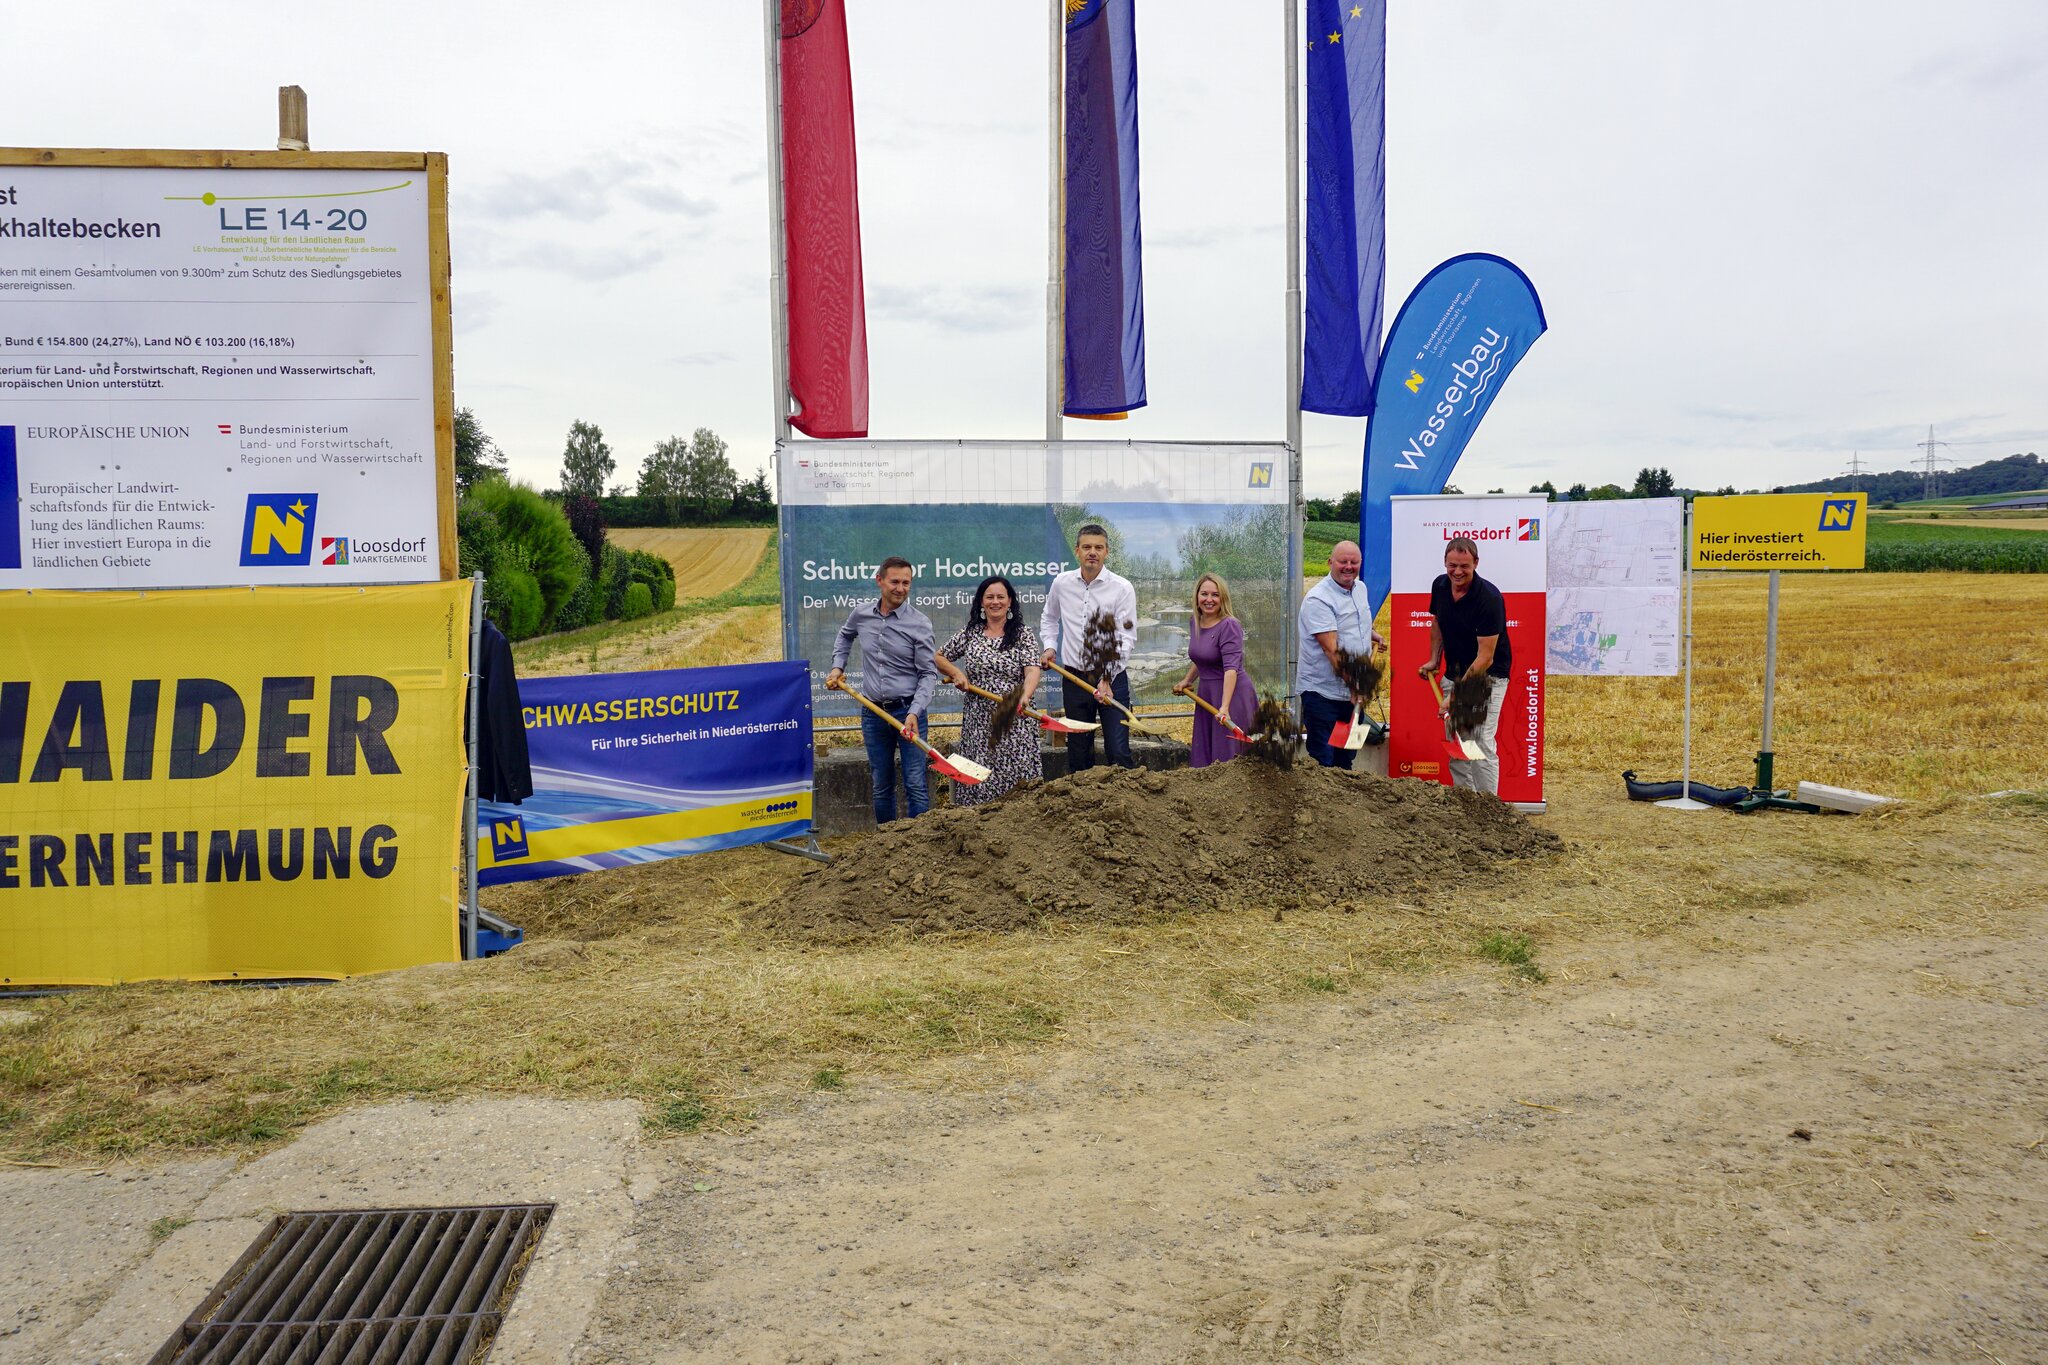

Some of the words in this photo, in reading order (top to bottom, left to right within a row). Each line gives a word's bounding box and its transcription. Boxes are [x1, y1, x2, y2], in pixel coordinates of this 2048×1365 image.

[220, 208, 267, 231] LE
[221, 236, 267, 244] Entwicklung
[270, 236, 281, 244] für
[283, 236, 297, 244] den
[300, 235, 342, 244] Ländlichen
[344, 236, 365, 244] Raum
[21, 267, 37, 277] mit
[40, 267, 71, 277] einem
[75, 267, 157, 277] Gesamtvolumen
[252, 268, 286, 278] Schutz
[289, 268, 307, 278] des
[311, 268, 402, 280] Siedlungsgebietes
[1460, 278, 1481, 306] Regionen
[1423, 292, 1463, 350] Bundesministerium
[5, 337, 34, 347] Bund
[37, 337, 43, 346] €
[47, 336, 88, 347] 154.800
[92, 336, 141, 348] (24,27%),
[144, 336, 171, 347] Land
[174, 335, 191, 347] NÖ
[195, 337, 201, 347] €
[205, 337, 246, 347] 103.200
[249, 337, 295, 348] (16,18%)
[1438, 346, 1447, 358] und
[1444, 315, 1467, 345] Tourismus
[36, 365, 51, 375] für
[54, 365, 86, 375] Land-
[89, 365, 110, 375] und
[114, 365, 198, 376] Forstwirtschaft,
[201, 366, 253, 377] Regionen
[256, 366, 277, 375] und
[280, 365, 376, 376] Wasserwirtschaft,
[67, 379, 99, 389] Union
[103, 379, 164, 389] unterstützt.
[1394, 327, 1501, 470] Wasserbau
[28, 425, 136, 438] EUROPÄISCHE
[140, 426, 190, 438] UNION
[239, 425, 348, 434] Bundesministerium
[240, 439, 272, 449] Land-
[276, 439, 296, 448] und
[301, 438, 393, 449] Forstwirtschaft,
[241, 454, 292, 466] Regionen
[296, 454, 317, 463] und
[322, 453, 423, 463] Wasserwirtschaft
[879, 470, 915, 479] Regionen
[30, 482, 114, 497] Europäischer
[117, 482, 179, 494] Landwirt-
[815, 480, 829, 488] und
[832, 480, 871, 488] Tourismus
[30, 500, 108, 512] schaftsfonds
[113, 500, 132, 512] für
[135, 500, 154, 512] die
[158, 500, 215, 512] Entwick-
[31, 519, 59, 533] lung
[62, 519, 83, 531] des
[87, 518, 153, 531] ländlichen
[157, 519, 205, 530] Raums:
[1443, 526, 1511, 540] Loosdorf
[1700, 533, 1730, 544] Hier
[1733, 532, 1804, 544] investiert
[32, 537, 60, 549] Hier
[64, 537, 122, 549] investiert
[126, 537, 172, 551] Europa
[177, 537, 188, 548] in
[192, 536, 211, 548] die
[353, 537, 426, 553] Loosdorf
[33, 555, 99, 568] ländlichen
[102, 555, 151, 567] Gebiete
[353, 555, 428, 563] MARKTGEMEINDE
[1699, 549, 1826, 562] Niederösterreich.
[802, 559, 880, 580] Schutz
[935, 556, 1069, 578] Hochwasser
[803, 595, 828, 608] Der
[915, 592, 950, 609] sorgt
[956, 591, 974, 605] für
[522, 690, 740, 729] CHWASSERSCHUTZ
[1526, 668, 1538, 777] www.loosdorf.at
[591, 738, 613, 751] Für
[615, 735, 638, 749] Ihre
[641, 729, 697, 746] Sicherheit
[700, 728, 710, 740] in
[712, 718, 798, 738] Niederösterreich
[741, 808, 765, 818] wasser
